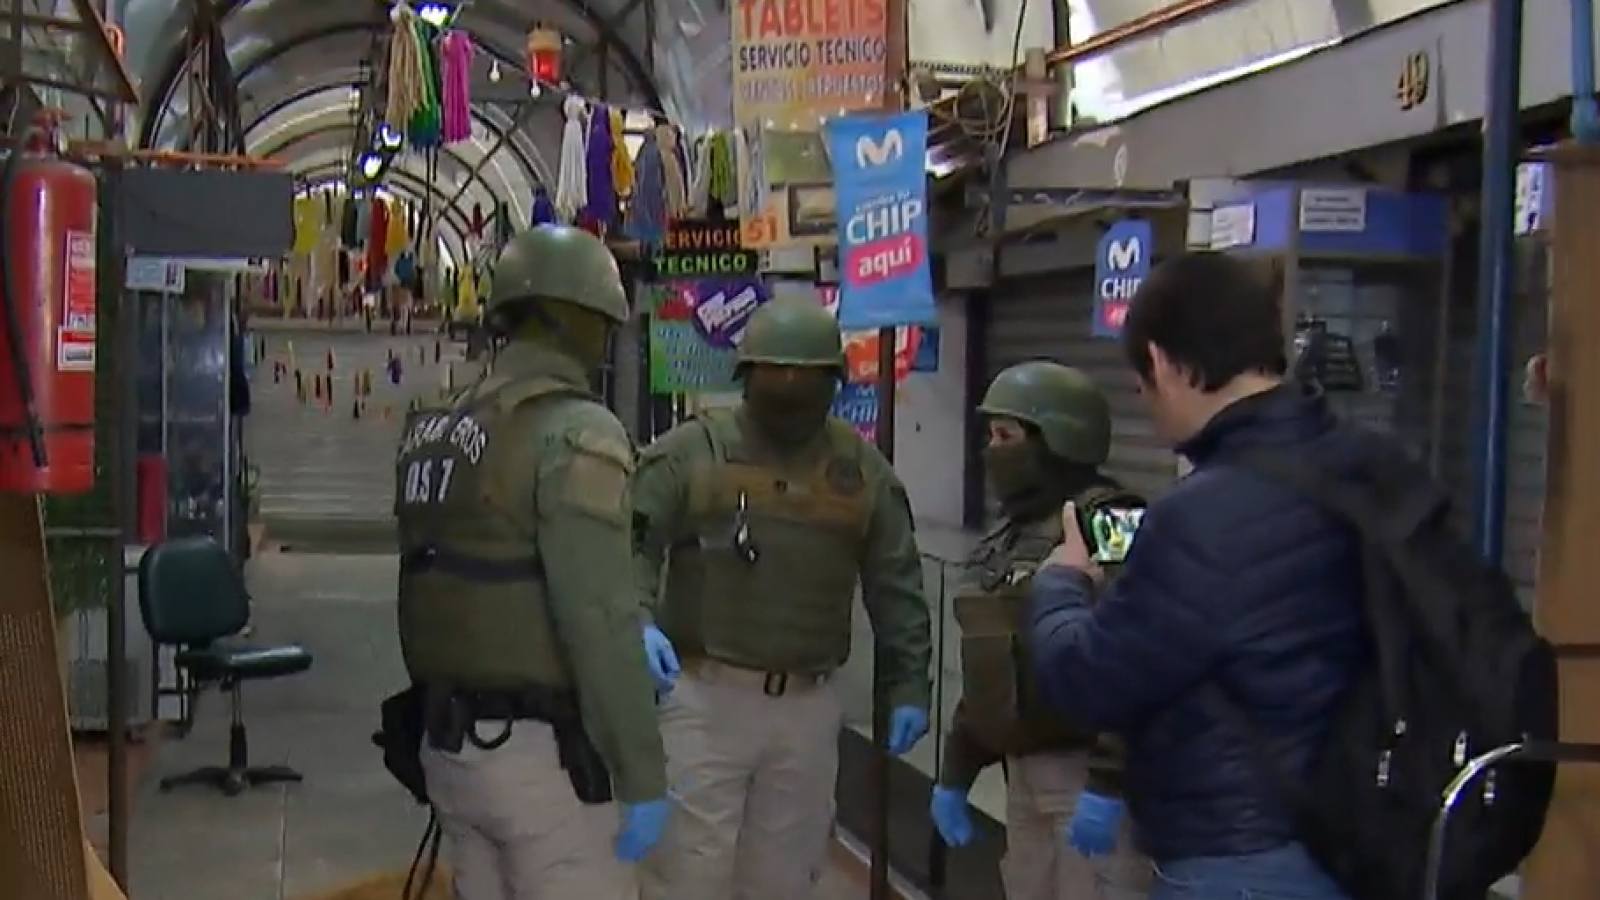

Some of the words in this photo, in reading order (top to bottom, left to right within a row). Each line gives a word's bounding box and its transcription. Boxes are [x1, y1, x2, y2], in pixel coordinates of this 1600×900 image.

[738, 0, 883, 39] TABLETS
[739, 42, 811, 72] SERVICIO
[816, 36, 886, 66] TECNICO
[1397, 53, 1428, 111] 49
[665, 228, 742, 249] ERVICIO
[846, 200, 922, 244] CHIP
[654, 253, 747, 275] TECNICO
[858, 236, 912, 278] aquí
[438, 459, 454, 502] 7
